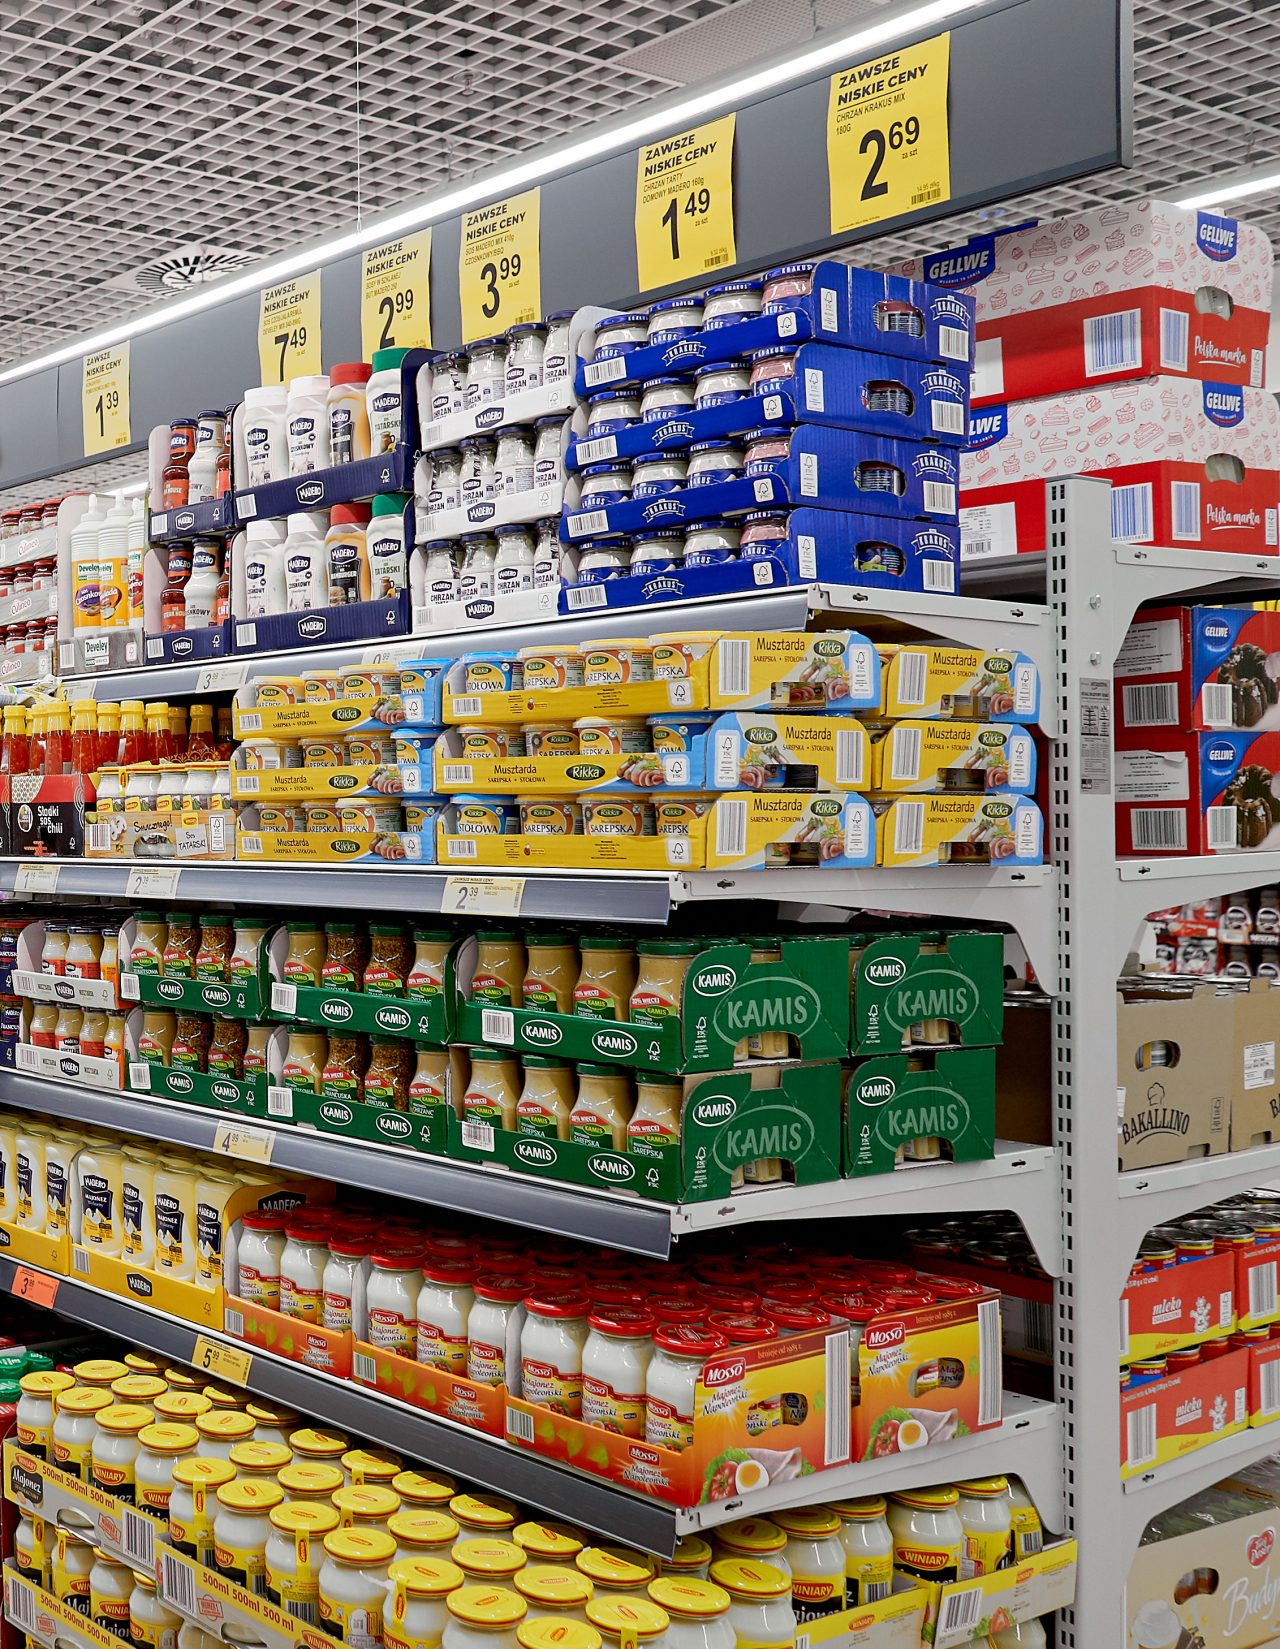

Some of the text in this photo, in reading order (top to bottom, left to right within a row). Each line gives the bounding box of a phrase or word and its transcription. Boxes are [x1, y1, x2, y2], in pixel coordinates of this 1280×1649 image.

[839, 56, 900, 88] ZAWSZE
[837, 64, 928, 106] NISKIE CENY
[836, 92, 906, 123] CHRZAN KRAKUS MIX
[645, 134, 695, 161] ZAWSZE
[644, 141, 717, 177] NISKIE CENY
[643, 172, 683, 192] CHRZAN TARTY
[667, 181, 690, 195] MADERO
[466, 204, 508, 226] ZAWSZE
[466, 212, 526, 241] NISKIE CENY
[1200, 222, 1235, 248] GELLWE
[367, 242, 403, 262] ZAWSZE
[366, 249, 419, 276] NISKIE CENY
[928, 250, 989, 281] GELLWE
[265, 283, 296, 301] ZAWSZE
[264, 290, 310, 313] NISKIE CENY
[86, 351, 111, 366] ZAWSZE
[669, 343, 701, 360] KRAKUS
[1195, 336, 1247, 365] Polska marka
[86, 359, 122, 377] NISKIE CENY
[1206, 391, 1241, 413] GELLWE
[476, 409, 505, 426] MADERO
[658, 423, 690, 440] KRAKUS
[299, 486, 322, 501] MADERO
[468, 505, 495, 519] MADERO
[649, 502, 680, 518] KRAKUS
[1207, 503, 1261, 526] Polska marka
[648, 580, 680, 596] KRAKUS
[430, 593, 455, 602] CHRZAN
[466, 603, 495, 617] MADERO
[300, 621, 324, 634] MADERO
[1205, 625, 1228, 638] GELLWE
[86, 640, 107, 655] Develey
[749, 729, 773, 742] Rikka
[927, 727, 971, 740] Musztarda
[982, 733, 1004, 746] Rikka
[1209, 749, 1234, 761] GELLWE
[494, 763, 537, 775] Musztarda
[572, 765, 600, 779] Rikka
[274, 774, 307, 784] Musztarda
[332, 777, 355, 788] Rikka
[753, 798, 802, 812] Musztarda
[814, 801, 840, 815] Rikka
[930, 800, 974, 813] Musztarda
[985, 803, 1009, 816] Rikka
[39, 816, 52, 826] sos
[47, 821, 63, 835] chili
[459, 824, 498, 834] STOŁOWA
[524, 824, 564, 834] SAREPSKA
[590, 824, 634, 834] SAREPSKA
[277, 837, 310, 848] Musztarda
[335, 841, 358, 852] Rikka
[897, 986, 967, 1016] KAMIS
[727, 996, 807, 1028] KAMIS
[525, 1025, 558, 1040] KAMIS
[597, 1035, 632, 1050] KAMIS
[697, 1103, 731, 1117] KAMIS
[888, 1104, 959, 1136] KAMIS
[1123, 1108, 1191, 1145] BAKALLINO
[726, 1123, 802, 1158] KAMIS
[517, 1144, 552, 1161] KAMIS
[592, 1161, 629, 1176] KAMIS
[84, 1192, 108, 1203] MAJONEZ
[157, 1213, 179, 1226] MAJONEZ
[1152, 1296, 1182, 1316] mleko
[869, 1328, 902, 1348] Mosso
[527, 1364, 552, 1378] Mosso
[708, 1362, 745, 1383] Mosso
[453, 1386, 476, 1399] Mosso
[711, 1386, 742, 1404] Majonez
[702, 1391, 750, 1416] Napoleoński
[1175, 1397, 1202, 1416] mleko
[630, 1447, 658, 1462] Mosso
[632, 1464, 662, 1479] Majonez
[12, 1468, 42, 1493] Majonez
[66, 1477, 115, 1510] 500ml 500 ml
[904, 1551, 949, 1567] WINIARY
[203, 1572, 295, 1632] 500ml 500ml 500 ml
[1223, 1567, 1280, 1637] Budy
